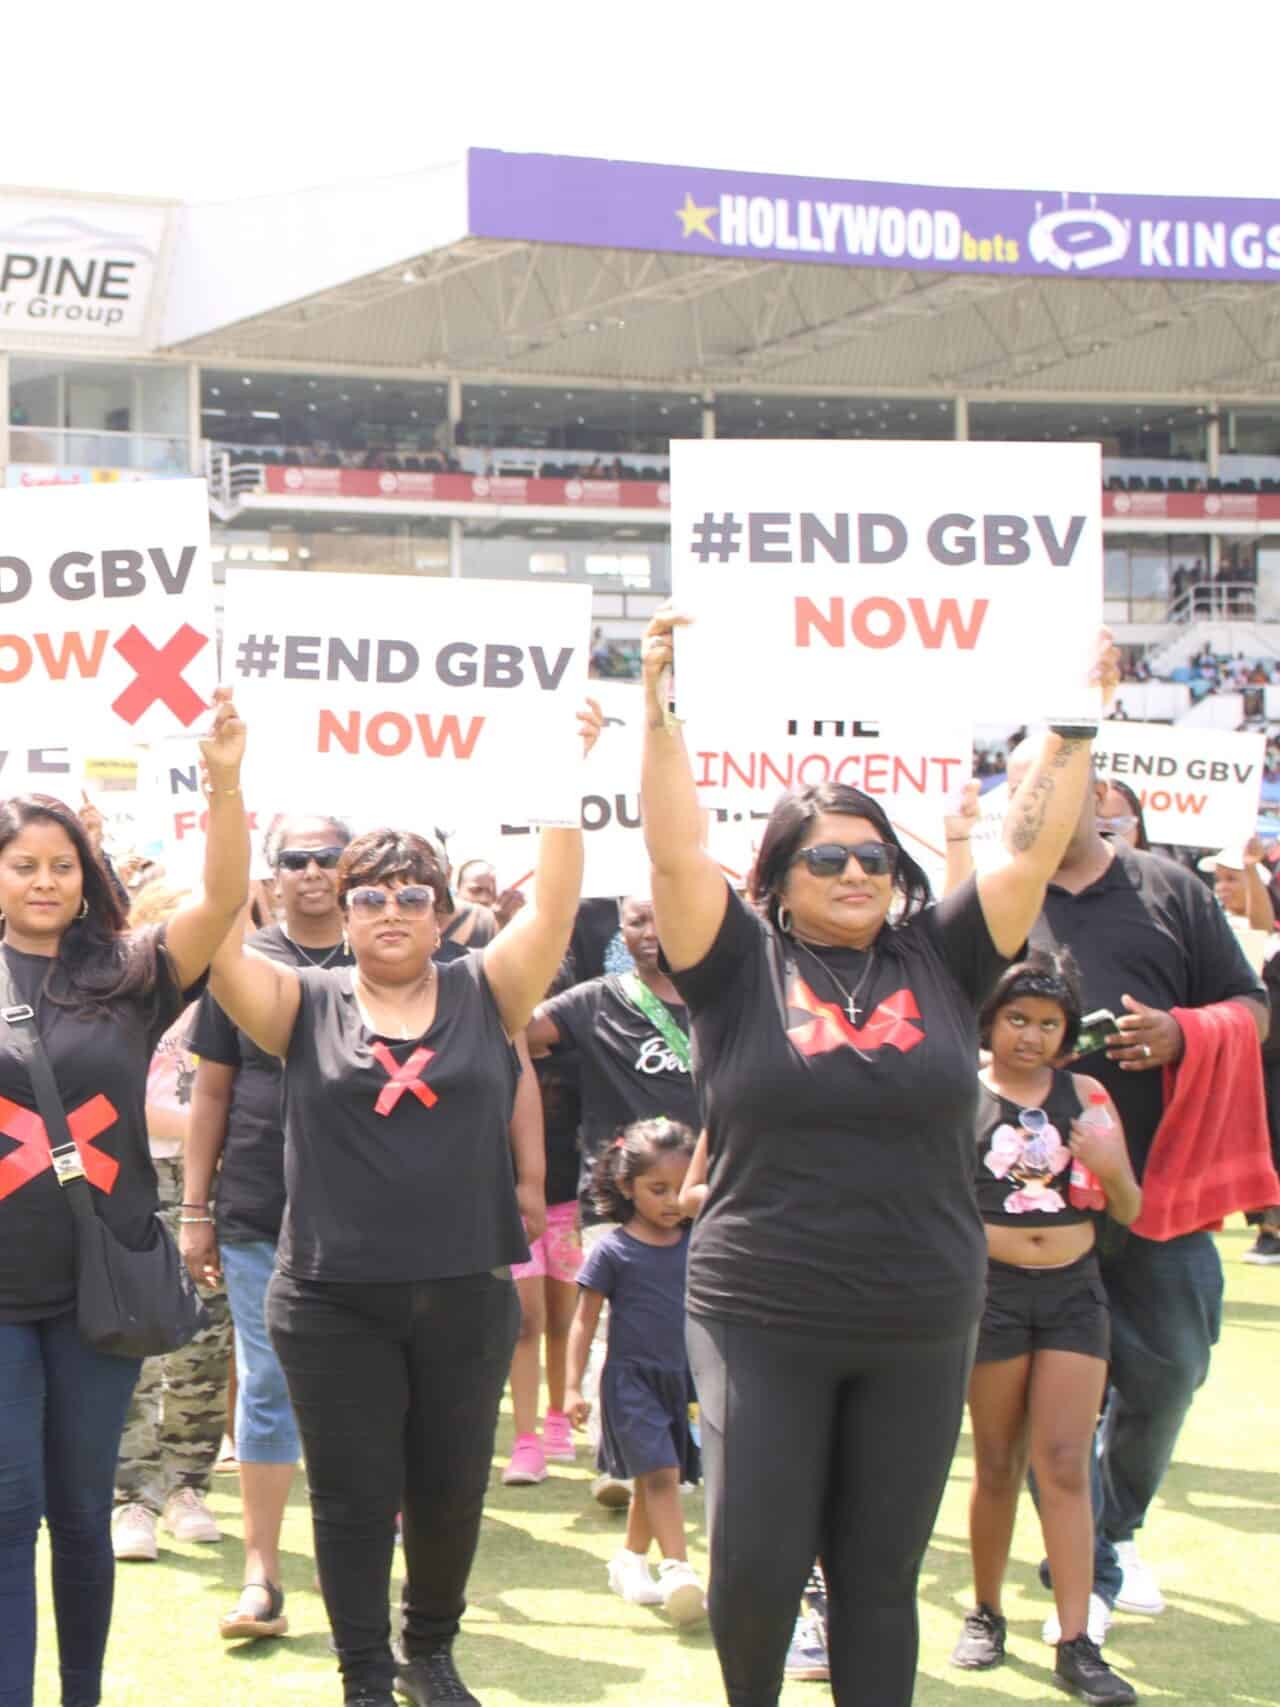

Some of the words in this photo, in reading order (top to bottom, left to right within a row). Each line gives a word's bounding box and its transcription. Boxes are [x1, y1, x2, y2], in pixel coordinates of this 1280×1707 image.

[26, 296, 125, 328] Group
[690, 511, 909, 564] #END
[926, 513, 1088, 567] GBV
[49, 546, 198, 601] GBV
[793, 595, 990, 650] NOW
[235, 633, 421, 684] #END
[435, 641, 575, 691] GBV
[317, 708, 486, 760] NOW
[696, 751, 962, 795] INNOCENT
[1093, 751, 1177, 778] #END
[1186, 758, 1256, 784] GBV
